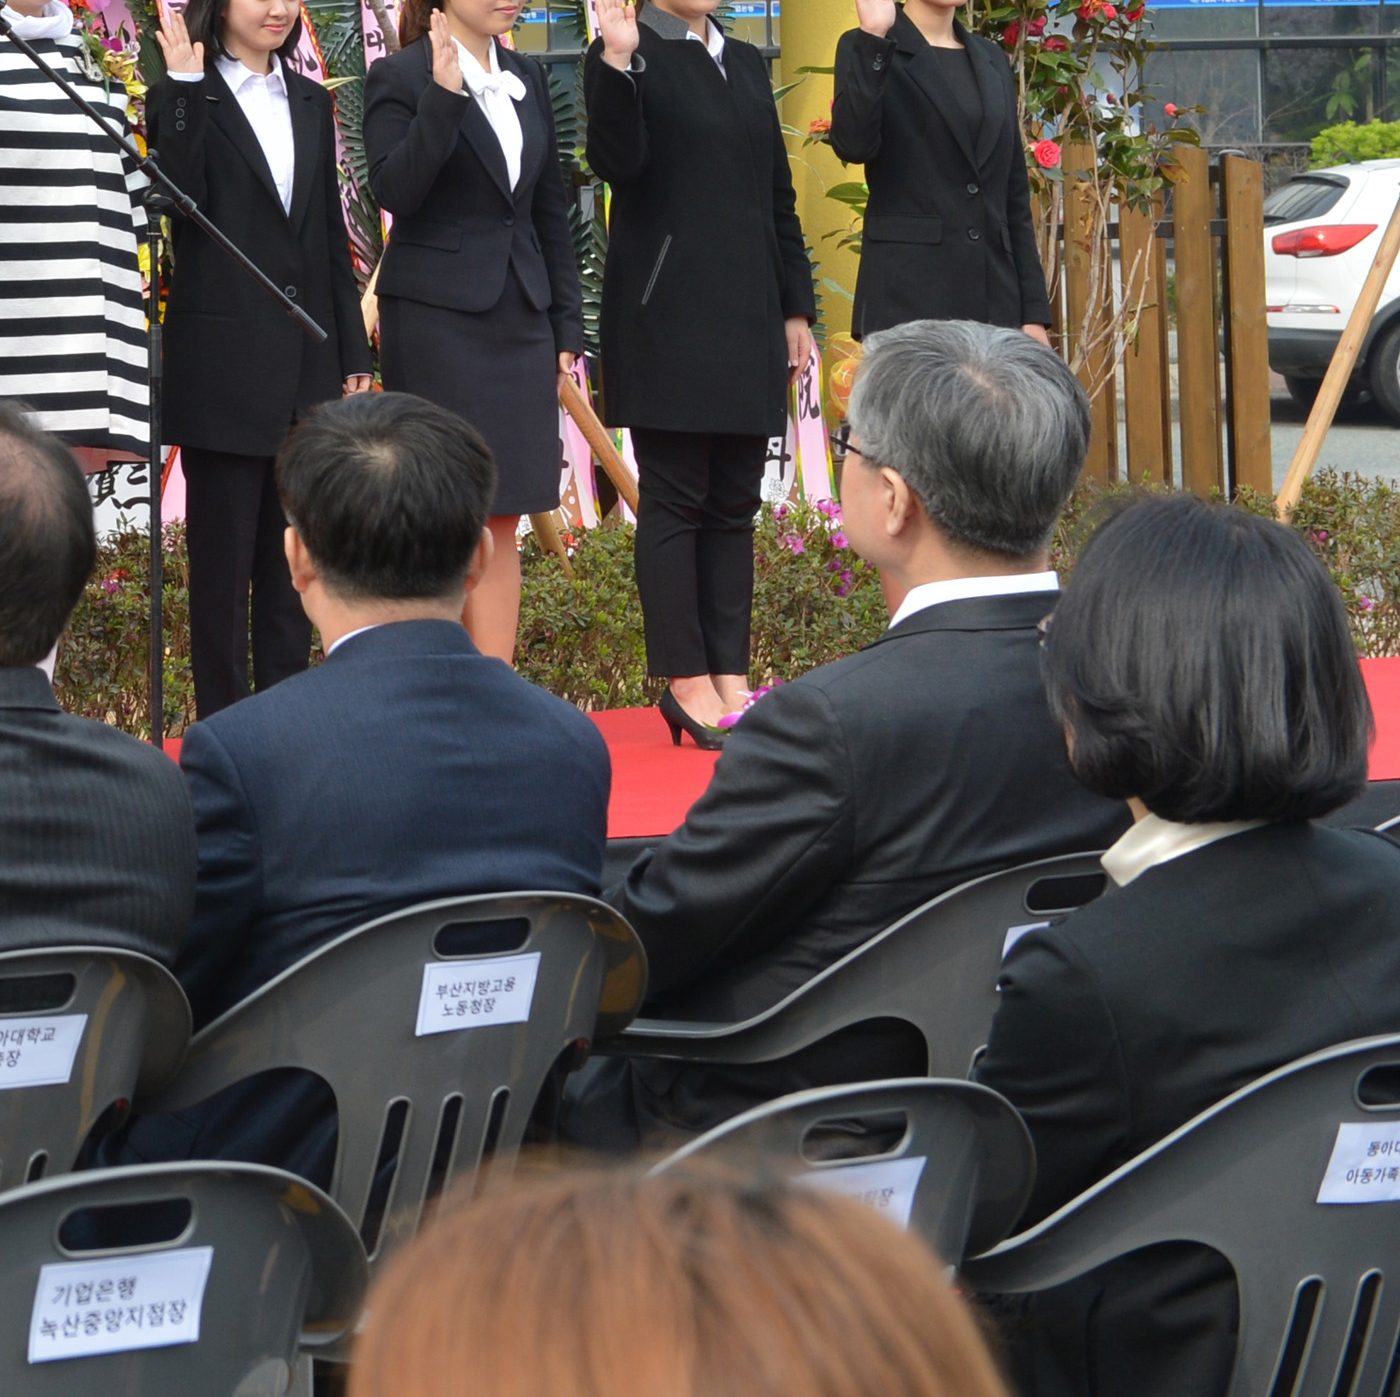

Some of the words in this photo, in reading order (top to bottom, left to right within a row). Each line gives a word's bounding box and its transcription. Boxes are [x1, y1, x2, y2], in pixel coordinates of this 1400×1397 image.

[436, 976, 517, 1000] 부산지방고용
[441, 996, 497, 1018] 노동청장
[51, 1274, 138, 1307] 기업은행
[39, 1298, 188, 1341] 녹산중앙지점장
